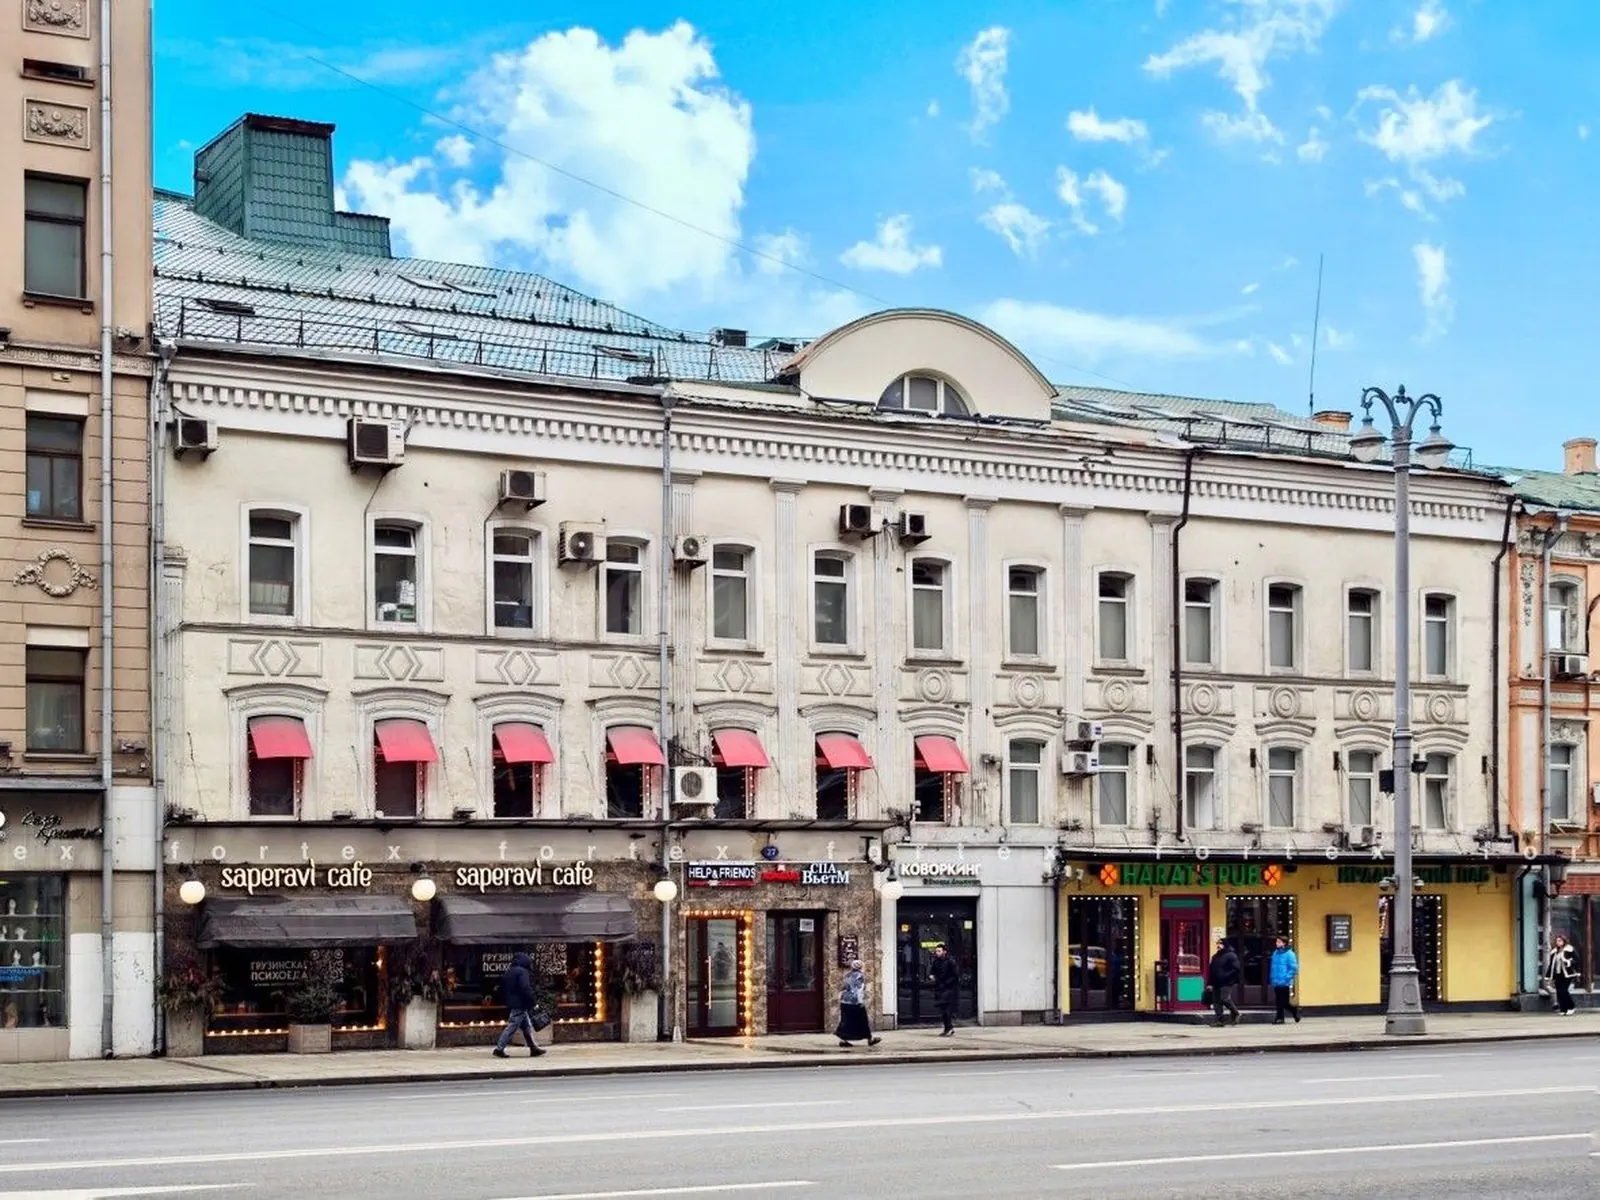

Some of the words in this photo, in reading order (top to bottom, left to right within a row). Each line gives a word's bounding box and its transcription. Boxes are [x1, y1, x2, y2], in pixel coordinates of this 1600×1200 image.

[221, 858, 316, 896] saperavi
[327, 860, 373, 887] cafe
[456, 858, 542, 894] saperavi
[552, 860, 594, 886] cafe
[810, 863, 836, 874] СПА
[900, 862, 982, 877] КОВОРКИНГ
[1120, 863, 1213, 886] HARAT'S
[1217, 864, 1260, 886] PUB
